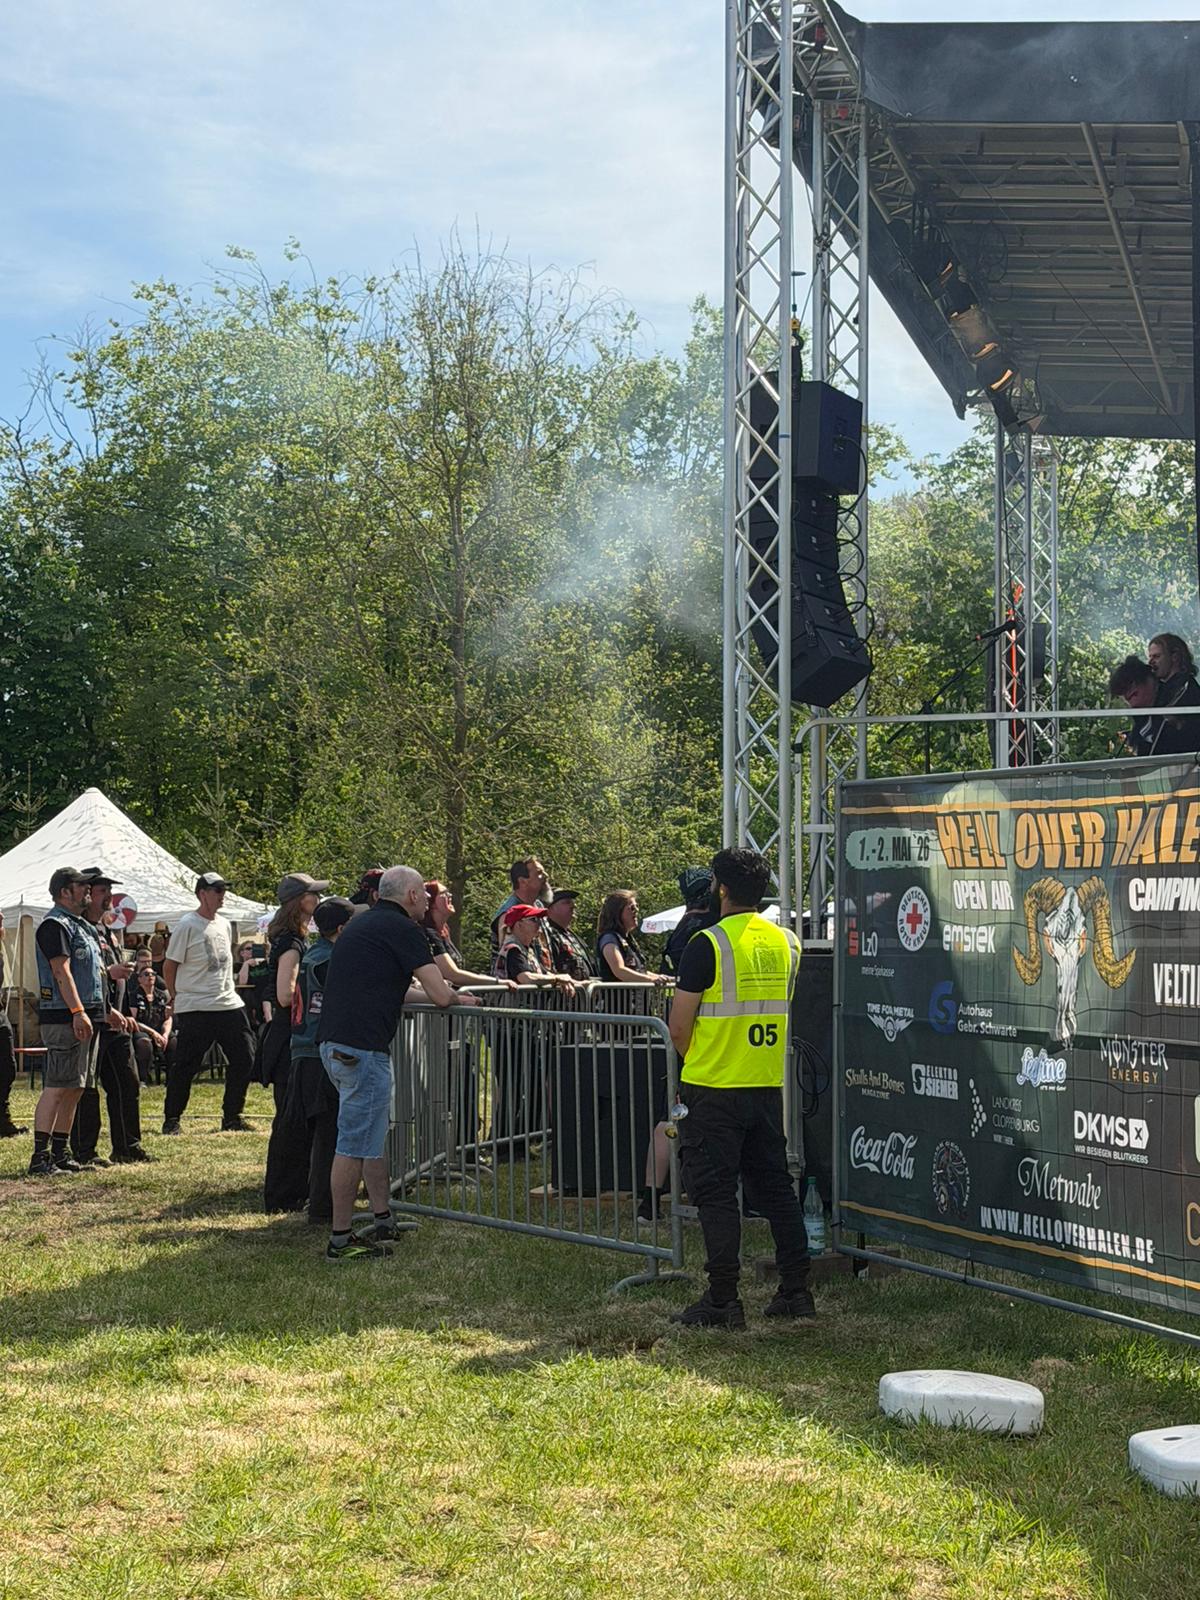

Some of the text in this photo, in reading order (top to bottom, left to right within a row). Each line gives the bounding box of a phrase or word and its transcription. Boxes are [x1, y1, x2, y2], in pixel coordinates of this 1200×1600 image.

[936, 802, 1200, 870] HELL OVER HALE
[892, 836, 911, 861] MAI
[953, 879, 1015, 911] OPEN AIR
[1129, 877, 1200, 912] CAMPIN
[1153, 963, 1200, 1007] VELTI
[893, 1006, 914, 1018] METAL
[957, 1002, 993, 1017] Autohaus
[748, 1023, 778, 1047] 05
[957, 1020, 1018, 1038] Gebr. Schwarte
[926, 1065, 958, 1081] ELEKTRO
[1111, 1068, 1158, 1084] ENERGY
[925, 1077, 959, 1100] SIEMER
[1074, 1110, 1129, 1147] DKMS
[1074, 1144, 1086, 1154] WIR
[1113, 1150, 1149, 1165] BLUTKREBS
